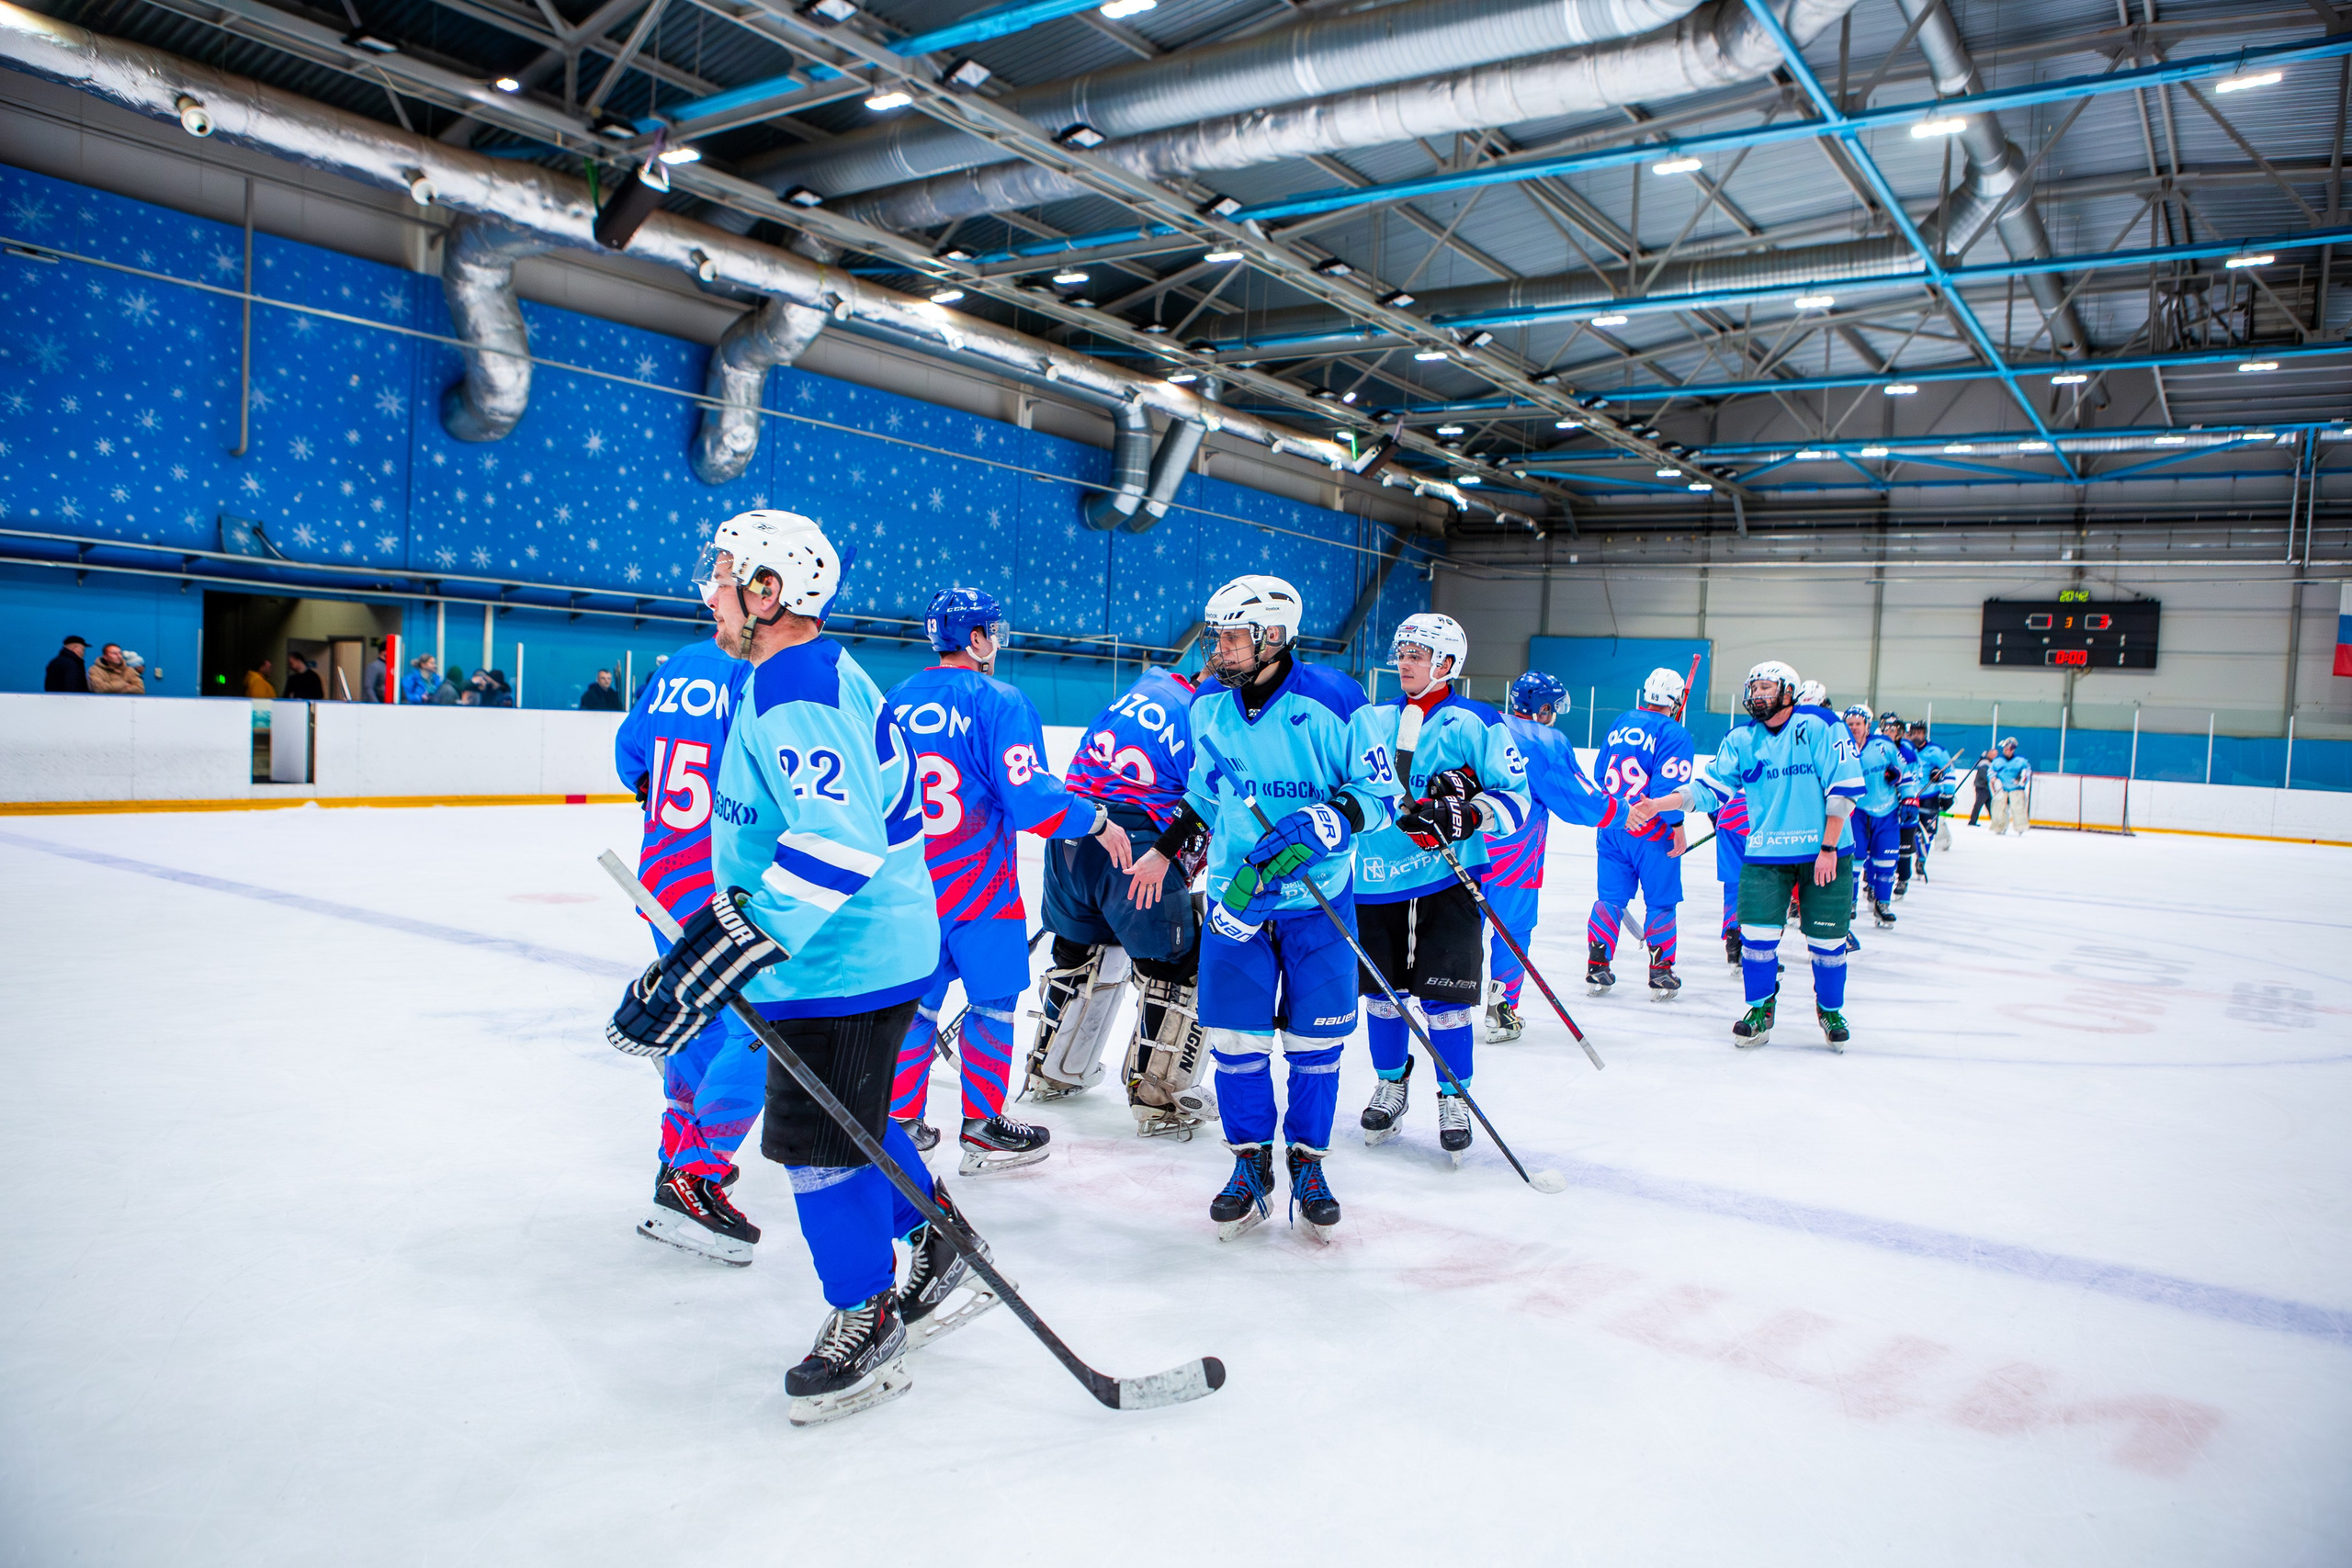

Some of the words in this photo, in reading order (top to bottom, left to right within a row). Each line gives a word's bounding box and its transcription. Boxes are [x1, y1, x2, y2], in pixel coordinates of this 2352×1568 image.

[2064, 616, 2074, 628] 3
[2098, 615, 2110, 628] 3
[2055, 649, 2087, 665] 0:00
[894, 702, 971, 739] ZON
[776, 745, 849, 806] 22
[1002, 743, 1050, 787] 8
[1360, 743, 1394, 784] 19
[1503, 745, 1530, 776] 3
[1604, 754, 1650, 797] 69
[1661, 756, 1691, 783] 69
[714, 790, 759, 827] БЭСК»
[917, 751, 966, 840] 3
[1766, 834, 1819, 845] АСТРУМ
[1441, 847, 1487, 904] CCM
[711, 888, 757, 948] RIOR
[1313, 1010, 1357, 1026] BAUER
[676, 1178, 709, 1216] CCM
[926, 1258, 966, 1304] VAPO
